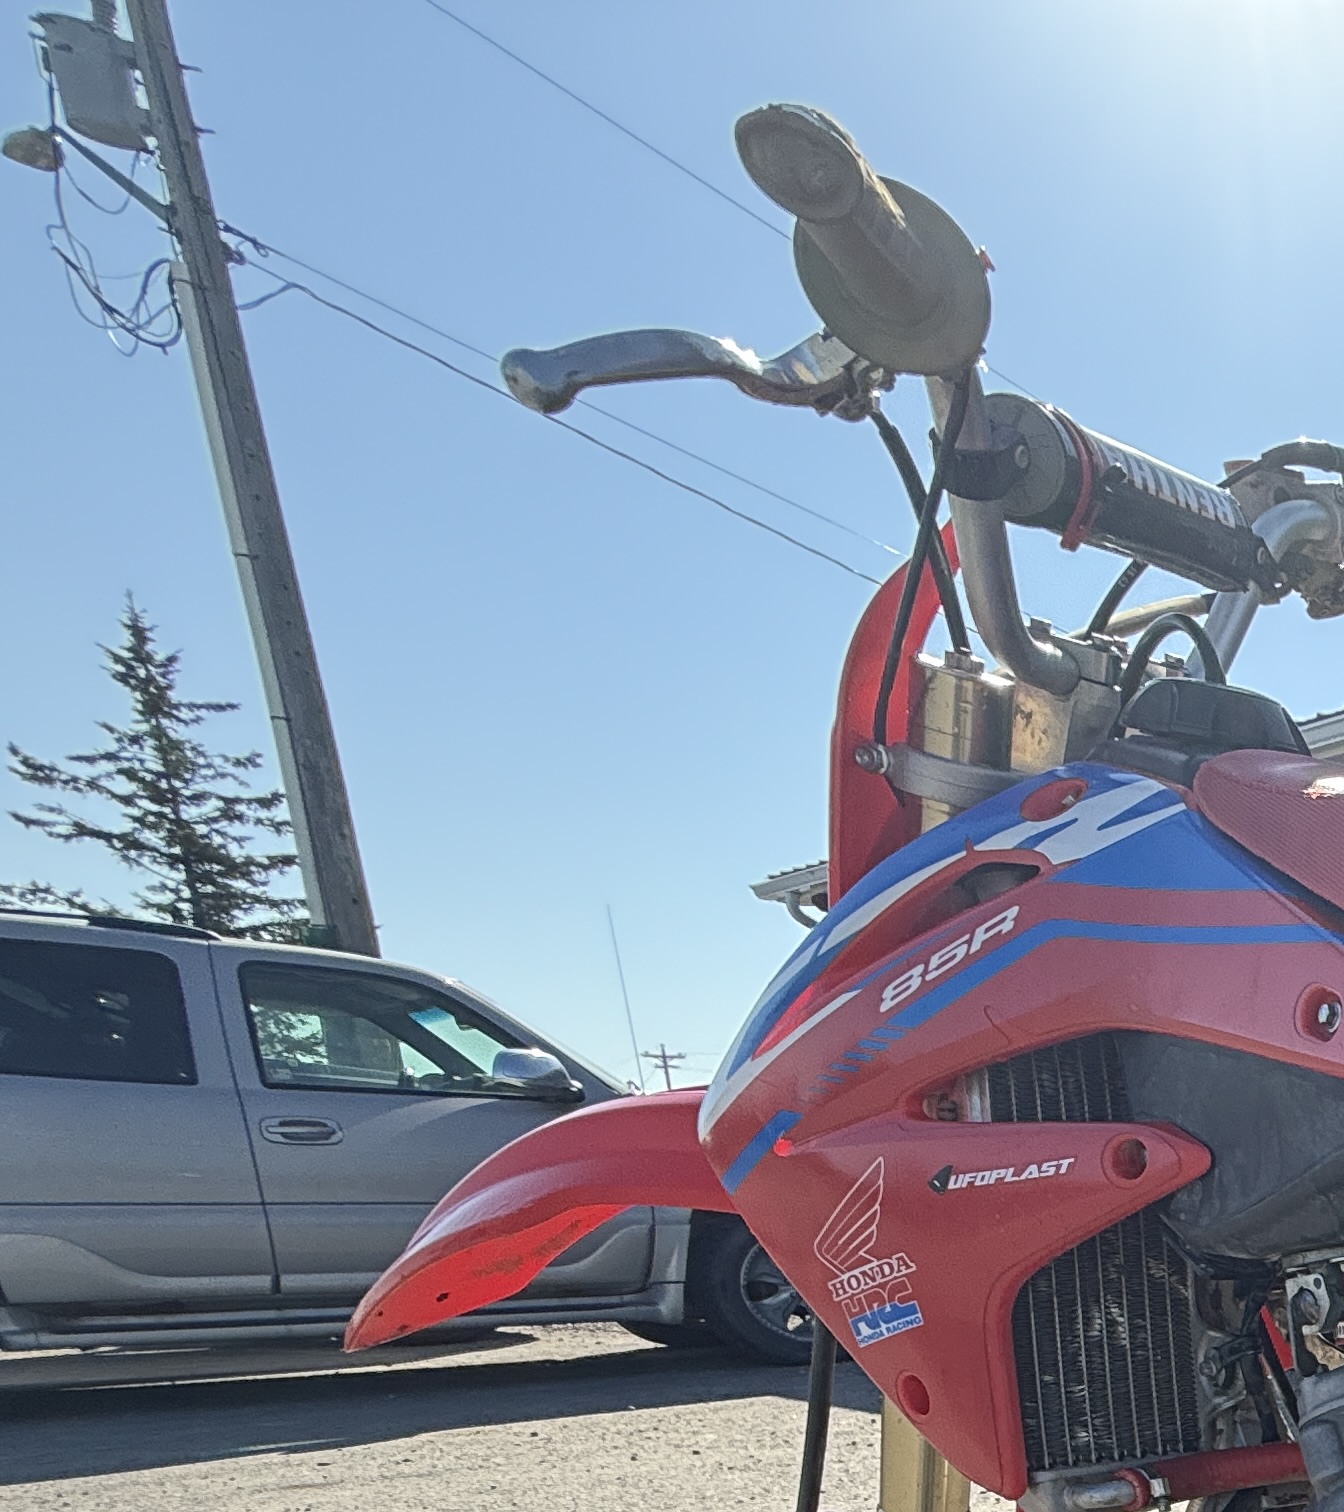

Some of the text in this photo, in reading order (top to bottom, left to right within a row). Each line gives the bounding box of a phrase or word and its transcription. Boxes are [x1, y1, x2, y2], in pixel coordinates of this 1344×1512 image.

[879, 905, 1020, 1014] 85R
[948, 1158, 1075, 1190] UFOPLAST
[830, 1254, 915, 1300] HONDA
[858, 1316, 922, 1346] HONDA RACING
